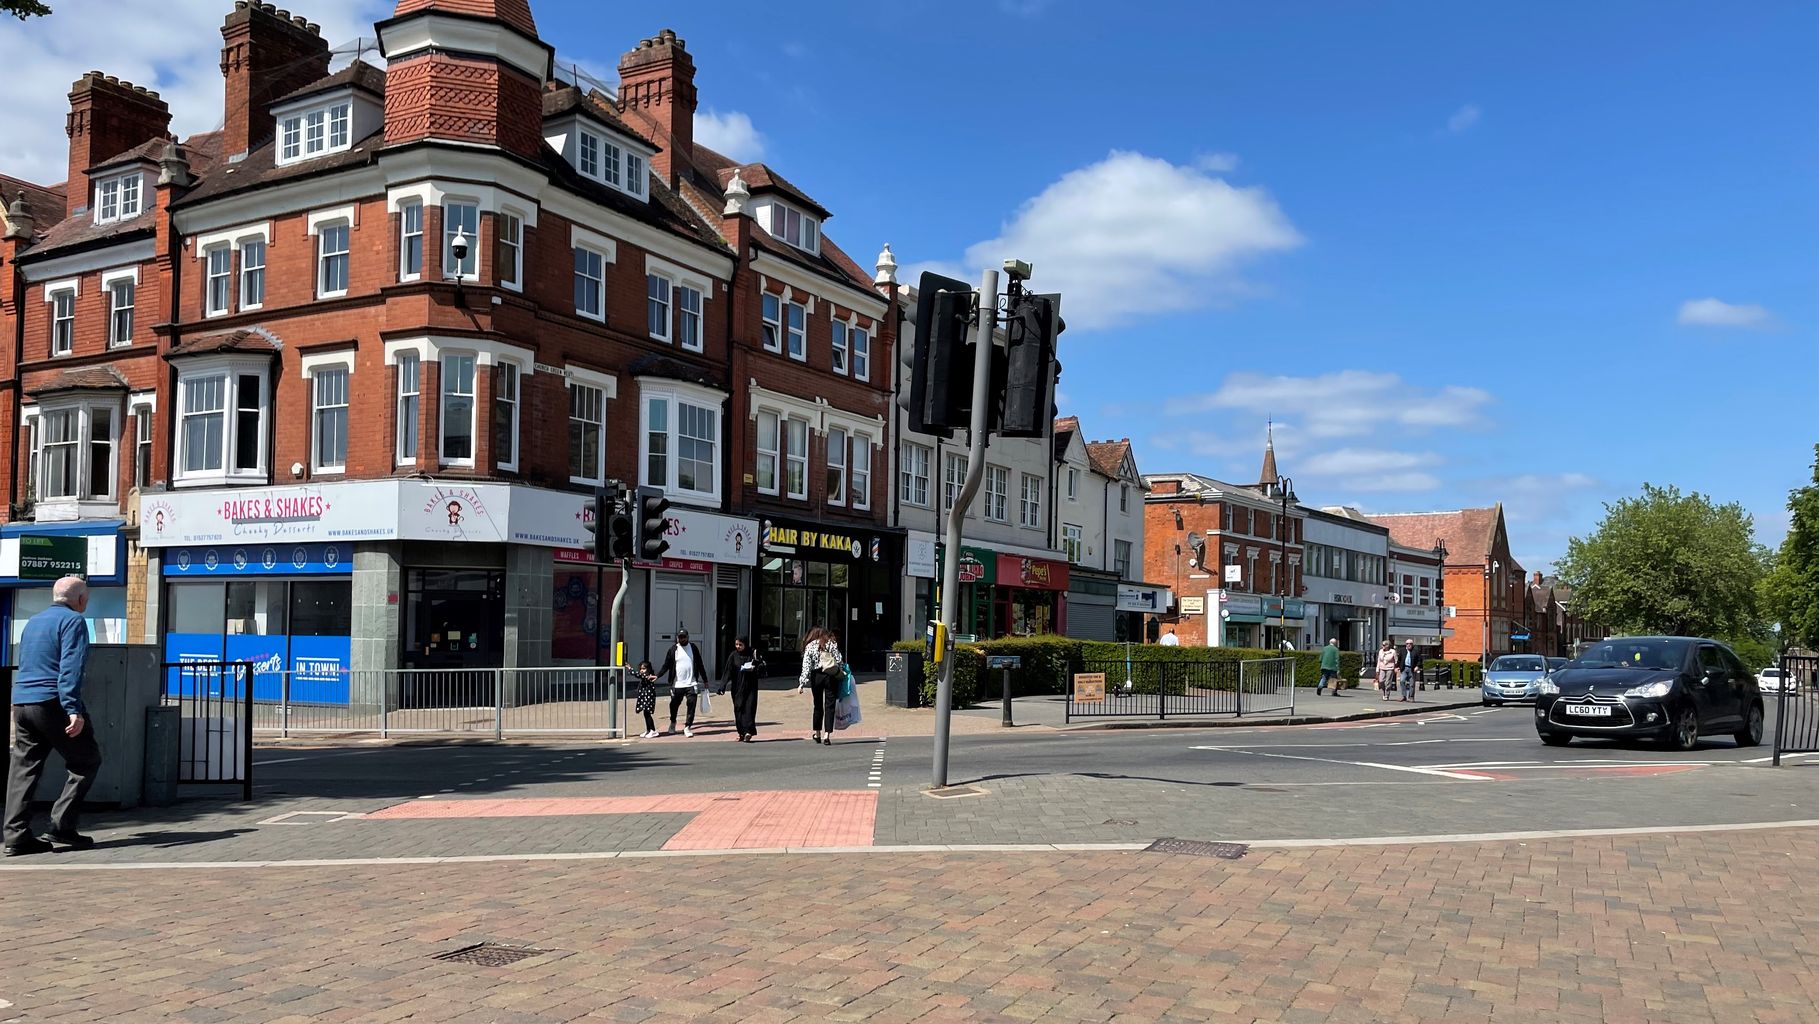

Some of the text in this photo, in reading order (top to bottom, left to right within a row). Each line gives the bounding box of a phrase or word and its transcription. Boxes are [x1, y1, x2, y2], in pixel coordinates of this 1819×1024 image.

[224, 496, 323, 519] BAKES & SHAKES
[460, 490, 484, 516] SHAKES
[769, 526, 852, 551] HAIR BY KAKA
[560, 551, 579, 560] WAFFLES
[21, 560, 81, 569] 07887 952215
[296, 661, 340, 676] IN TOWN!
[1569, 706, 1590, 714] LC60
